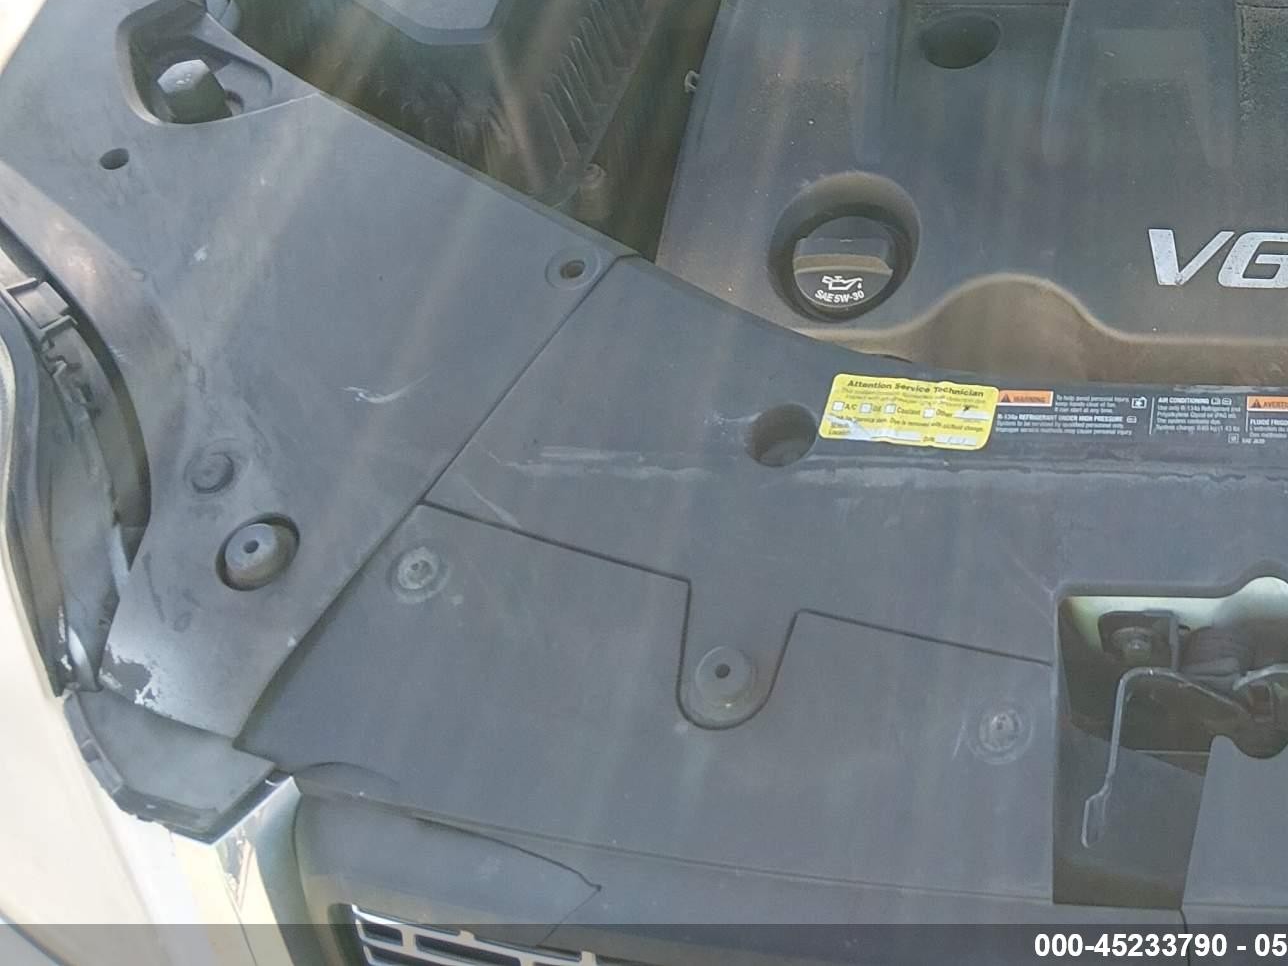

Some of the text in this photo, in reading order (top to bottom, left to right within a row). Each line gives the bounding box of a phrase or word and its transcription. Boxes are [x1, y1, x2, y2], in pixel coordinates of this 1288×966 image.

[815, 289, 865, 303] SAE 5W-30
[847, 380, 984, 397] Attention Service Technician
